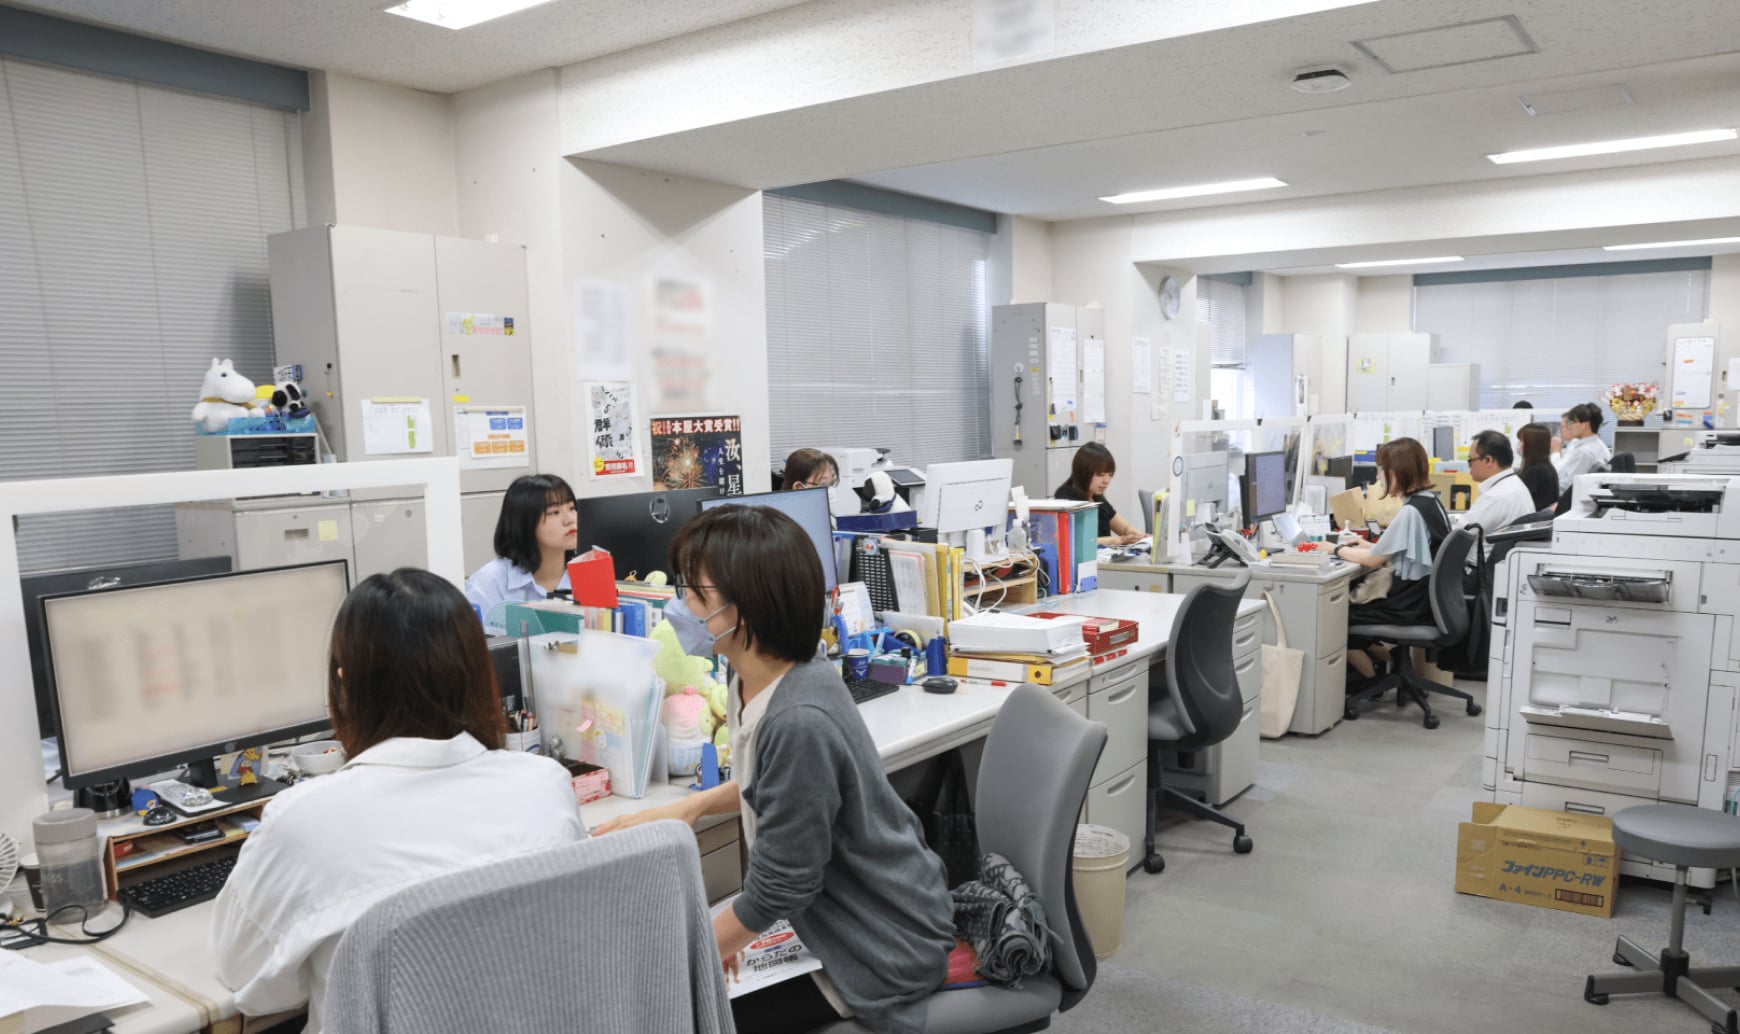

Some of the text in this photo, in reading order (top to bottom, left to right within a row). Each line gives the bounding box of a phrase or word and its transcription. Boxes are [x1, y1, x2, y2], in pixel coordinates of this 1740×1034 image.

[1501, 859, 1606, 887] ファインPPC-RW
[746, 944, 802, 967] からだの
